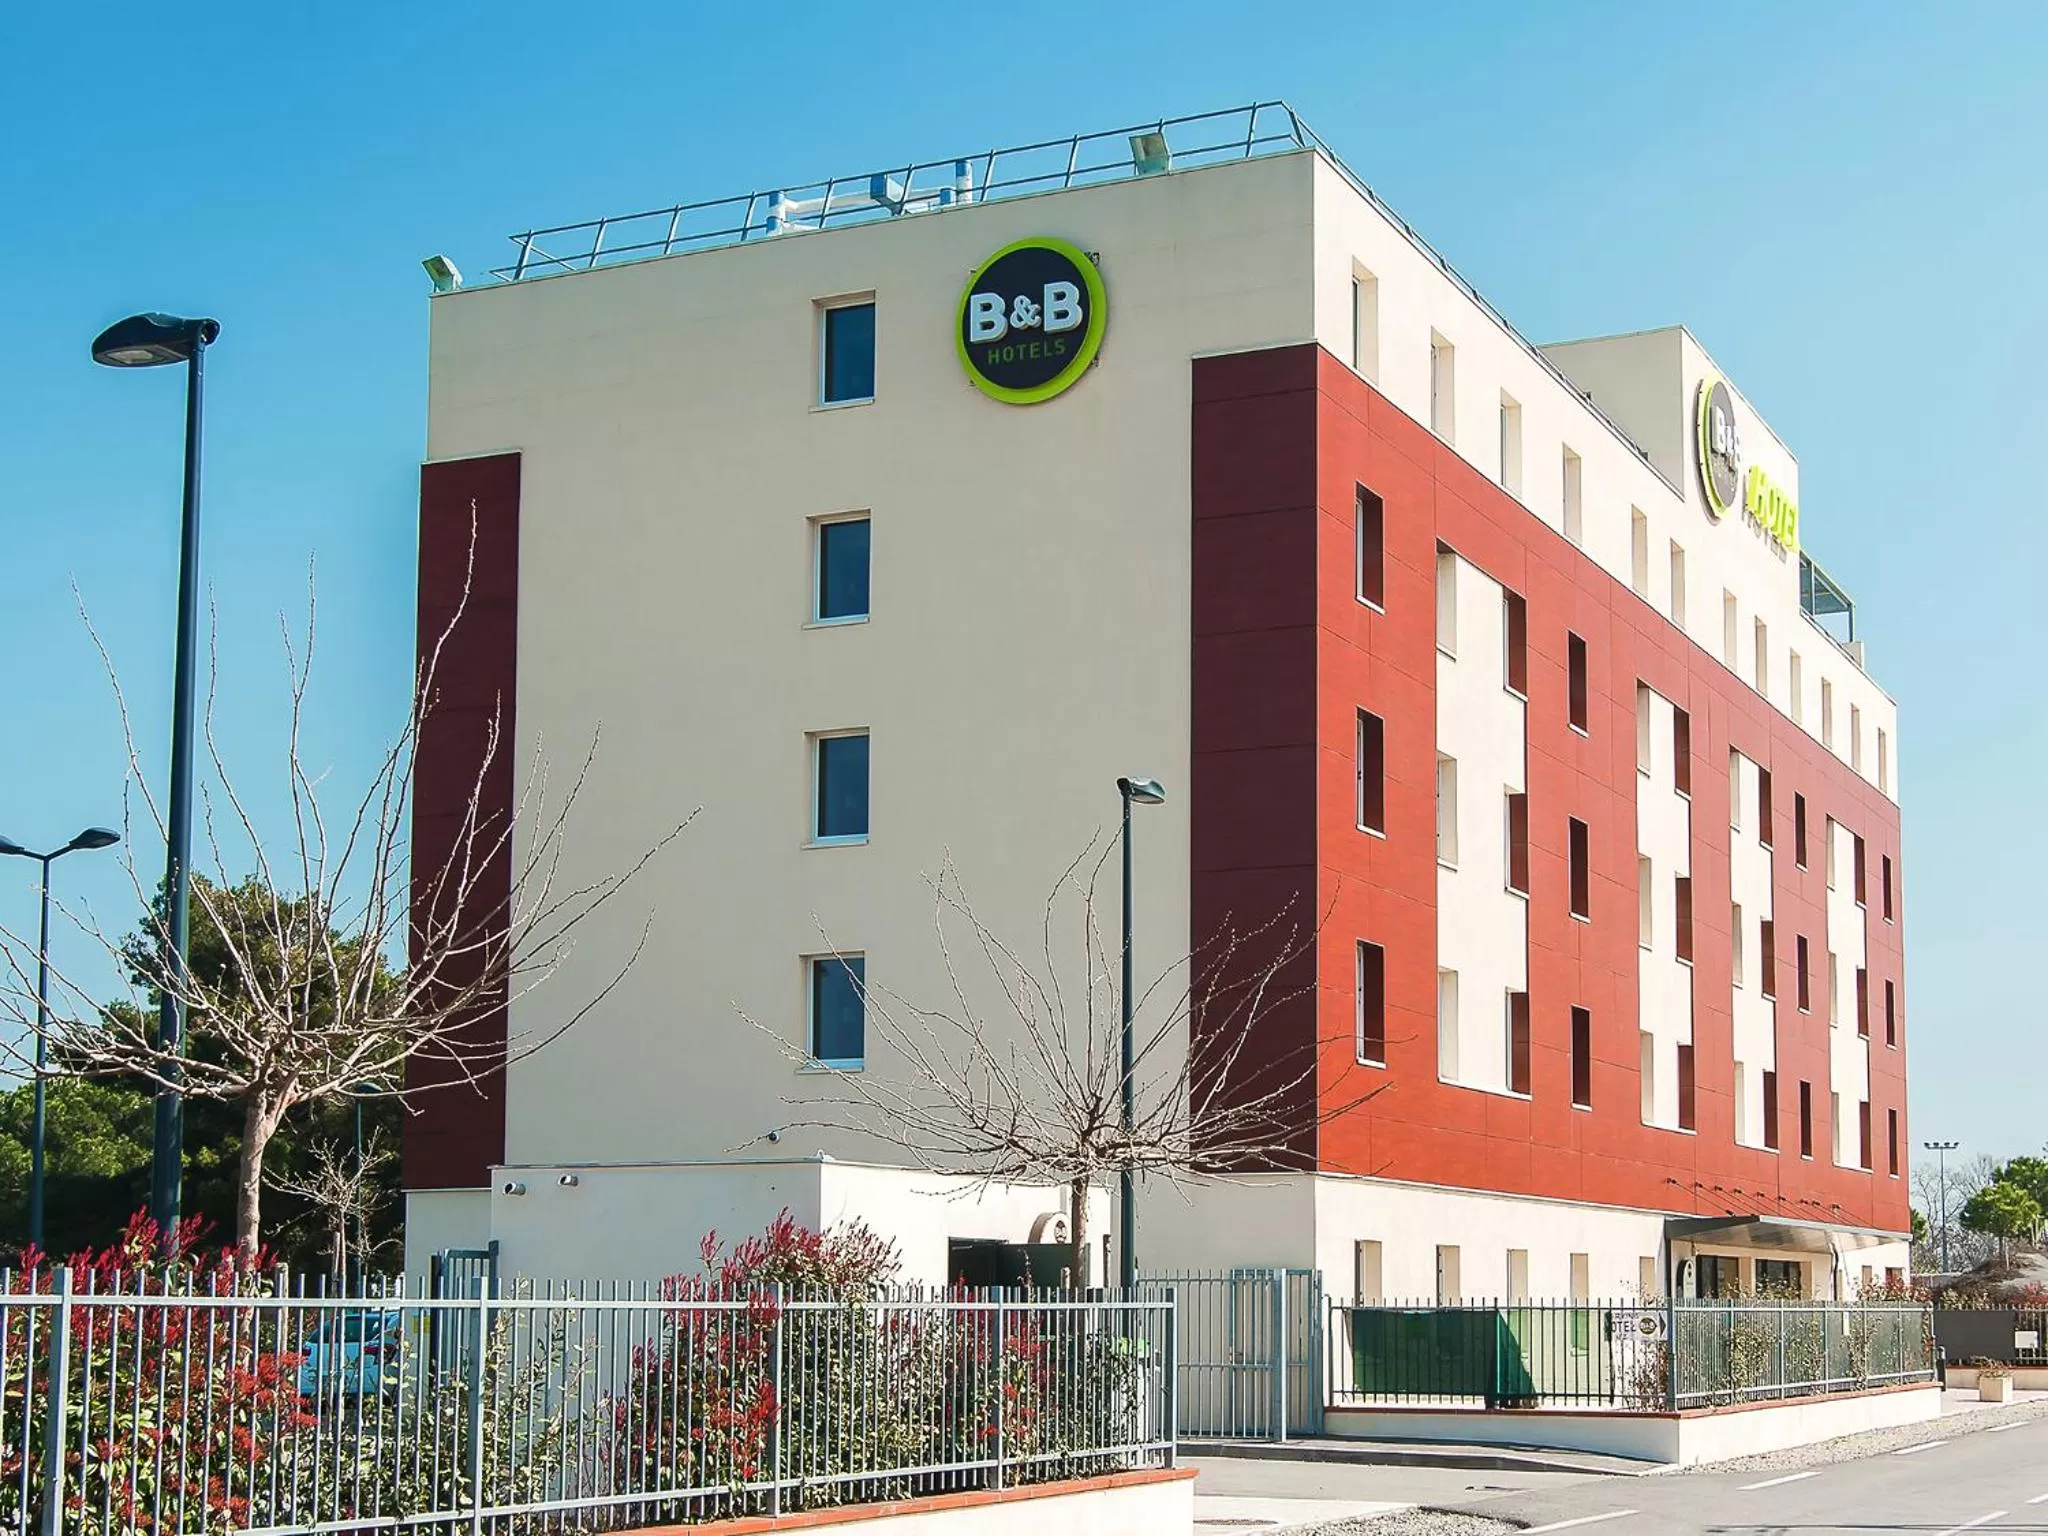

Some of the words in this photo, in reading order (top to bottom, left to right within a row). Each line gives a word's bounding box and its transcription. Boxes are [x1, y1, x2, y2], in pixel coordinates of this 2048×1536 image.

[970, 281, 1083, 343] B&B
[987, 338, 1066, 365] HOTELS
[1610, 1320, 1637, 1333] OTEL
